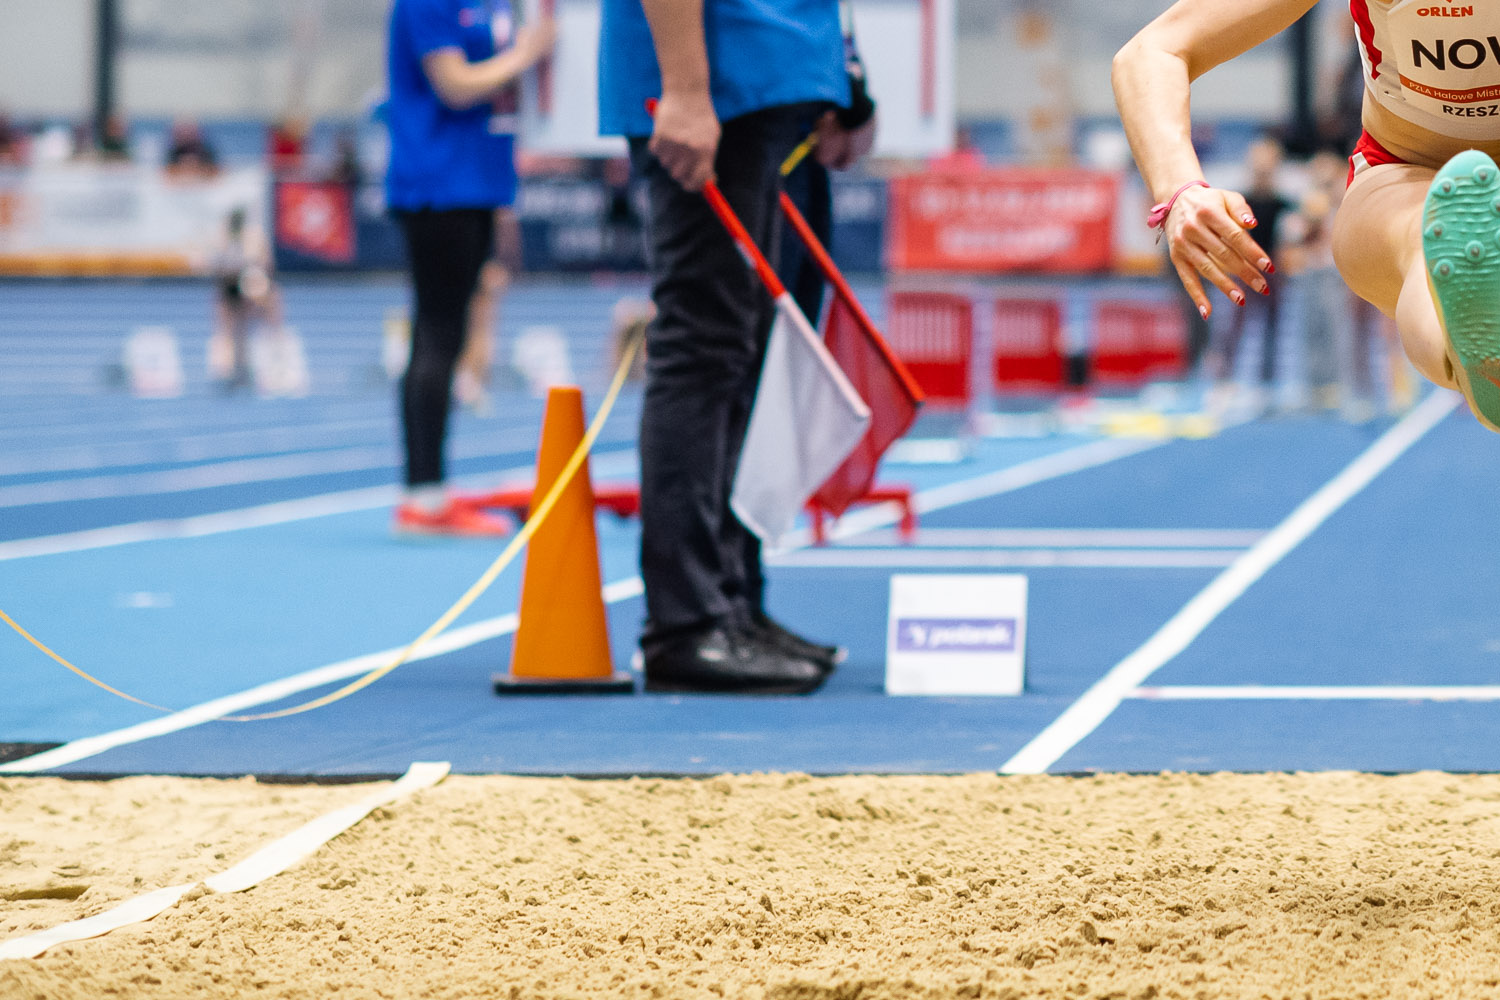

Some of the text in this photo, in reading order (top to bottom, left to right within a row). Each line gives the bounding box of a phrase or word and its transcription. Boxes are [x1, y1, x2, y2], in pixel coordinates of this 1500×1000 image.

[1416, 5, 1474, 18] ORLEN
[1409, 81, 1432, 96] PZLA
[1433, 89, 1474, 100] Halowe
